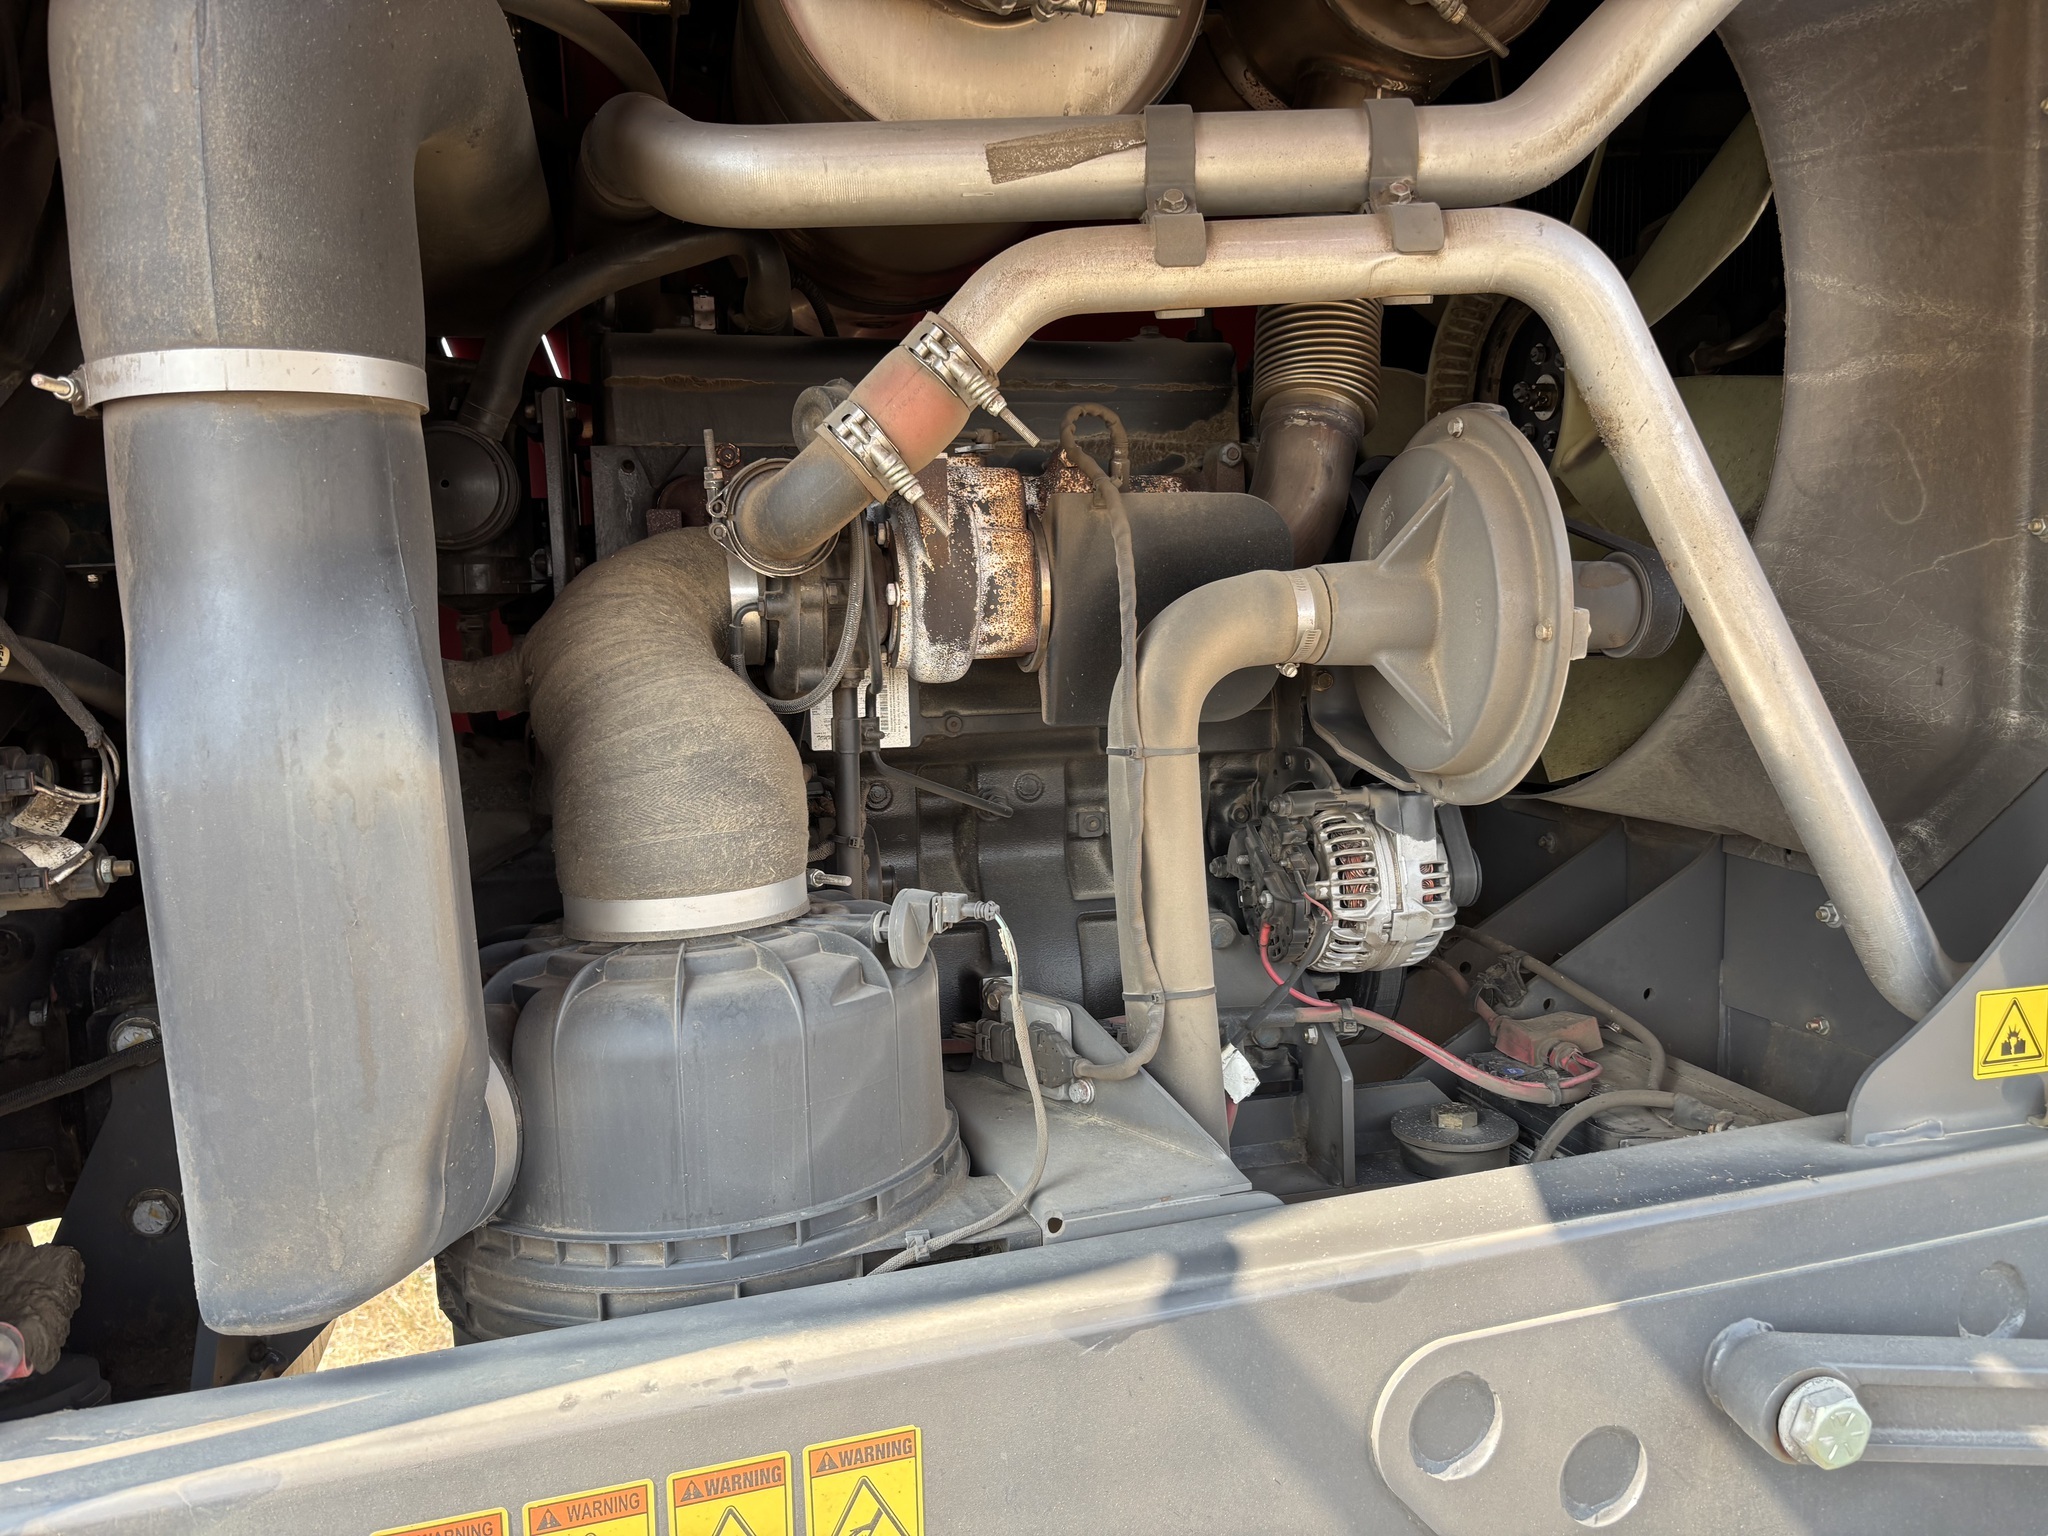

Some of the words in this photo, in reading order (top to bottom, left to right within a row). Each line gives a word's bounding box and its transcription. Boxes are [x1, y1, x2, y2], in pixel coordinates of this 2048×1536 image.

[838, 1438, 913, 1468] WARNING
[704, 1465, 782, 1497] WARNING
[566, 1492, 640, 1522] WARNING
